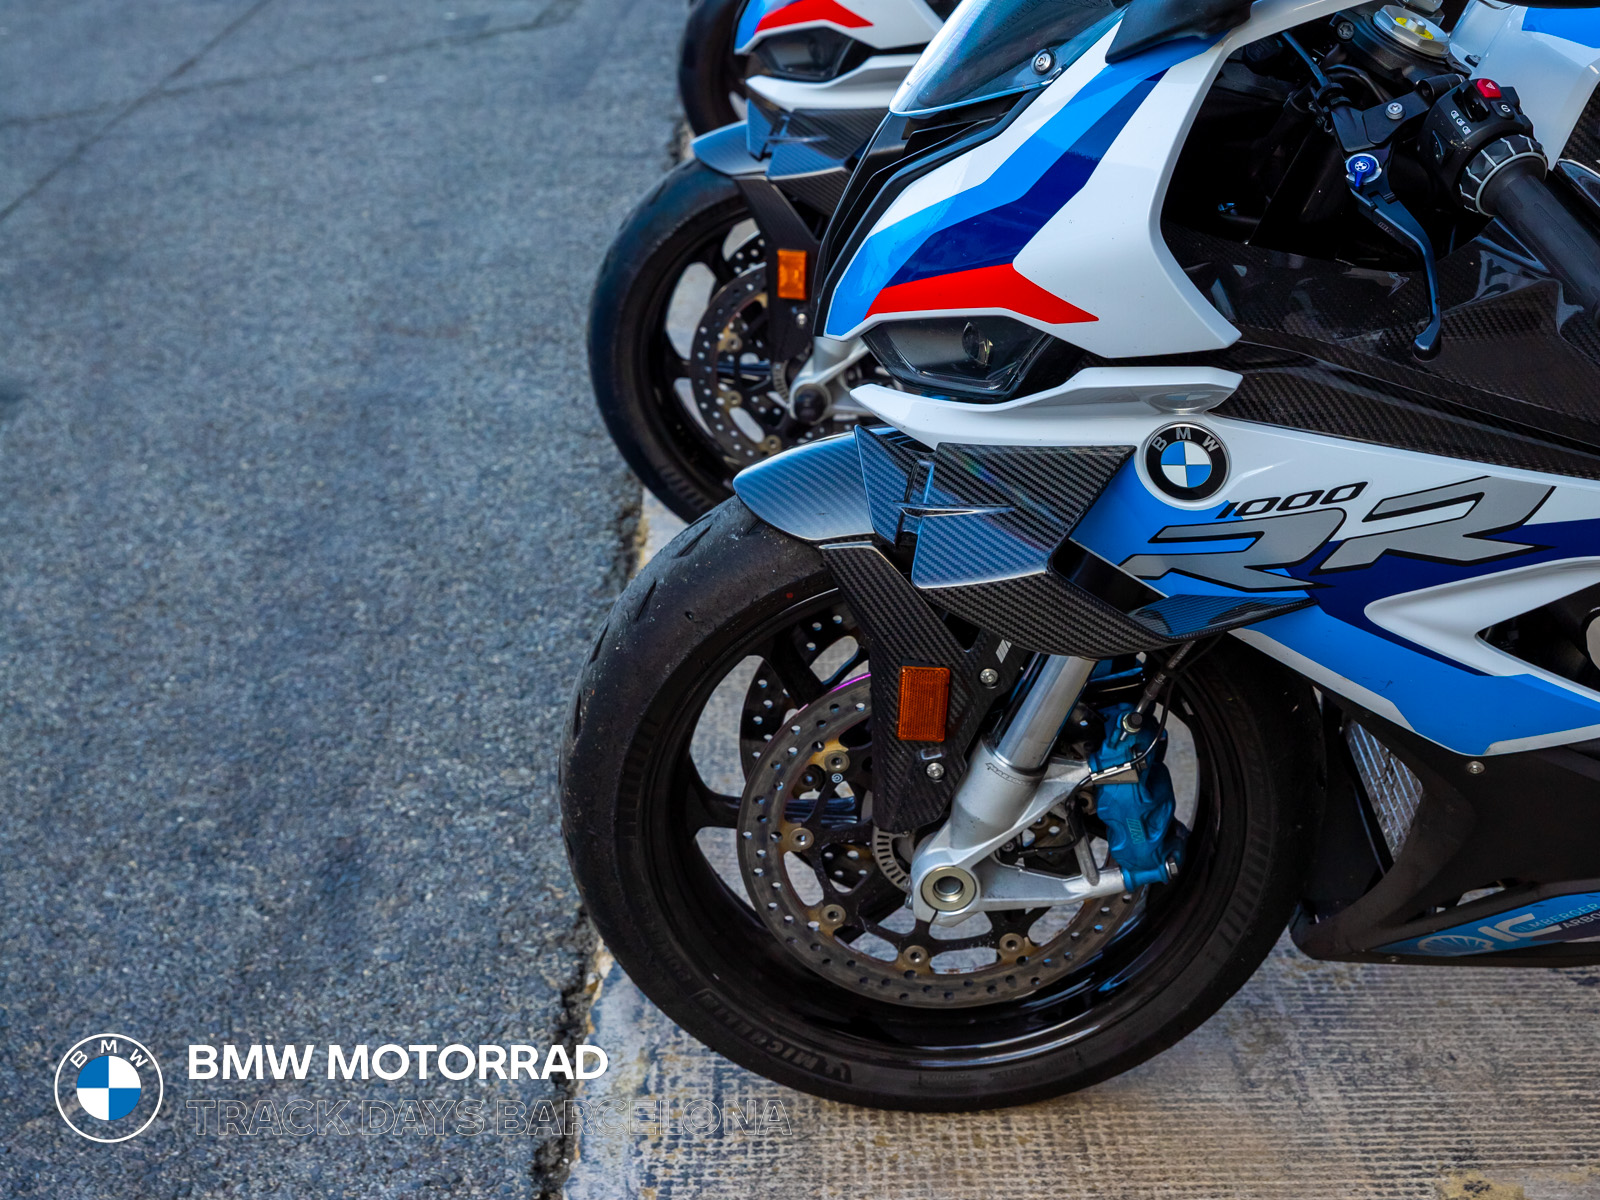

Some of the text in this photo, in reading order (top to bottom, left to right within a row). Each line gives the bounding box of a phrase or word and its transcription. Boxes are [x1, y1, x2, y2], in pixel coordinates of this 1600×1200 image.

[1151, 427, 1220, 453] BMW
[1216, 481, 1368, 519] 1000
[1514, 902, 1600, 932] ILMBERGER
